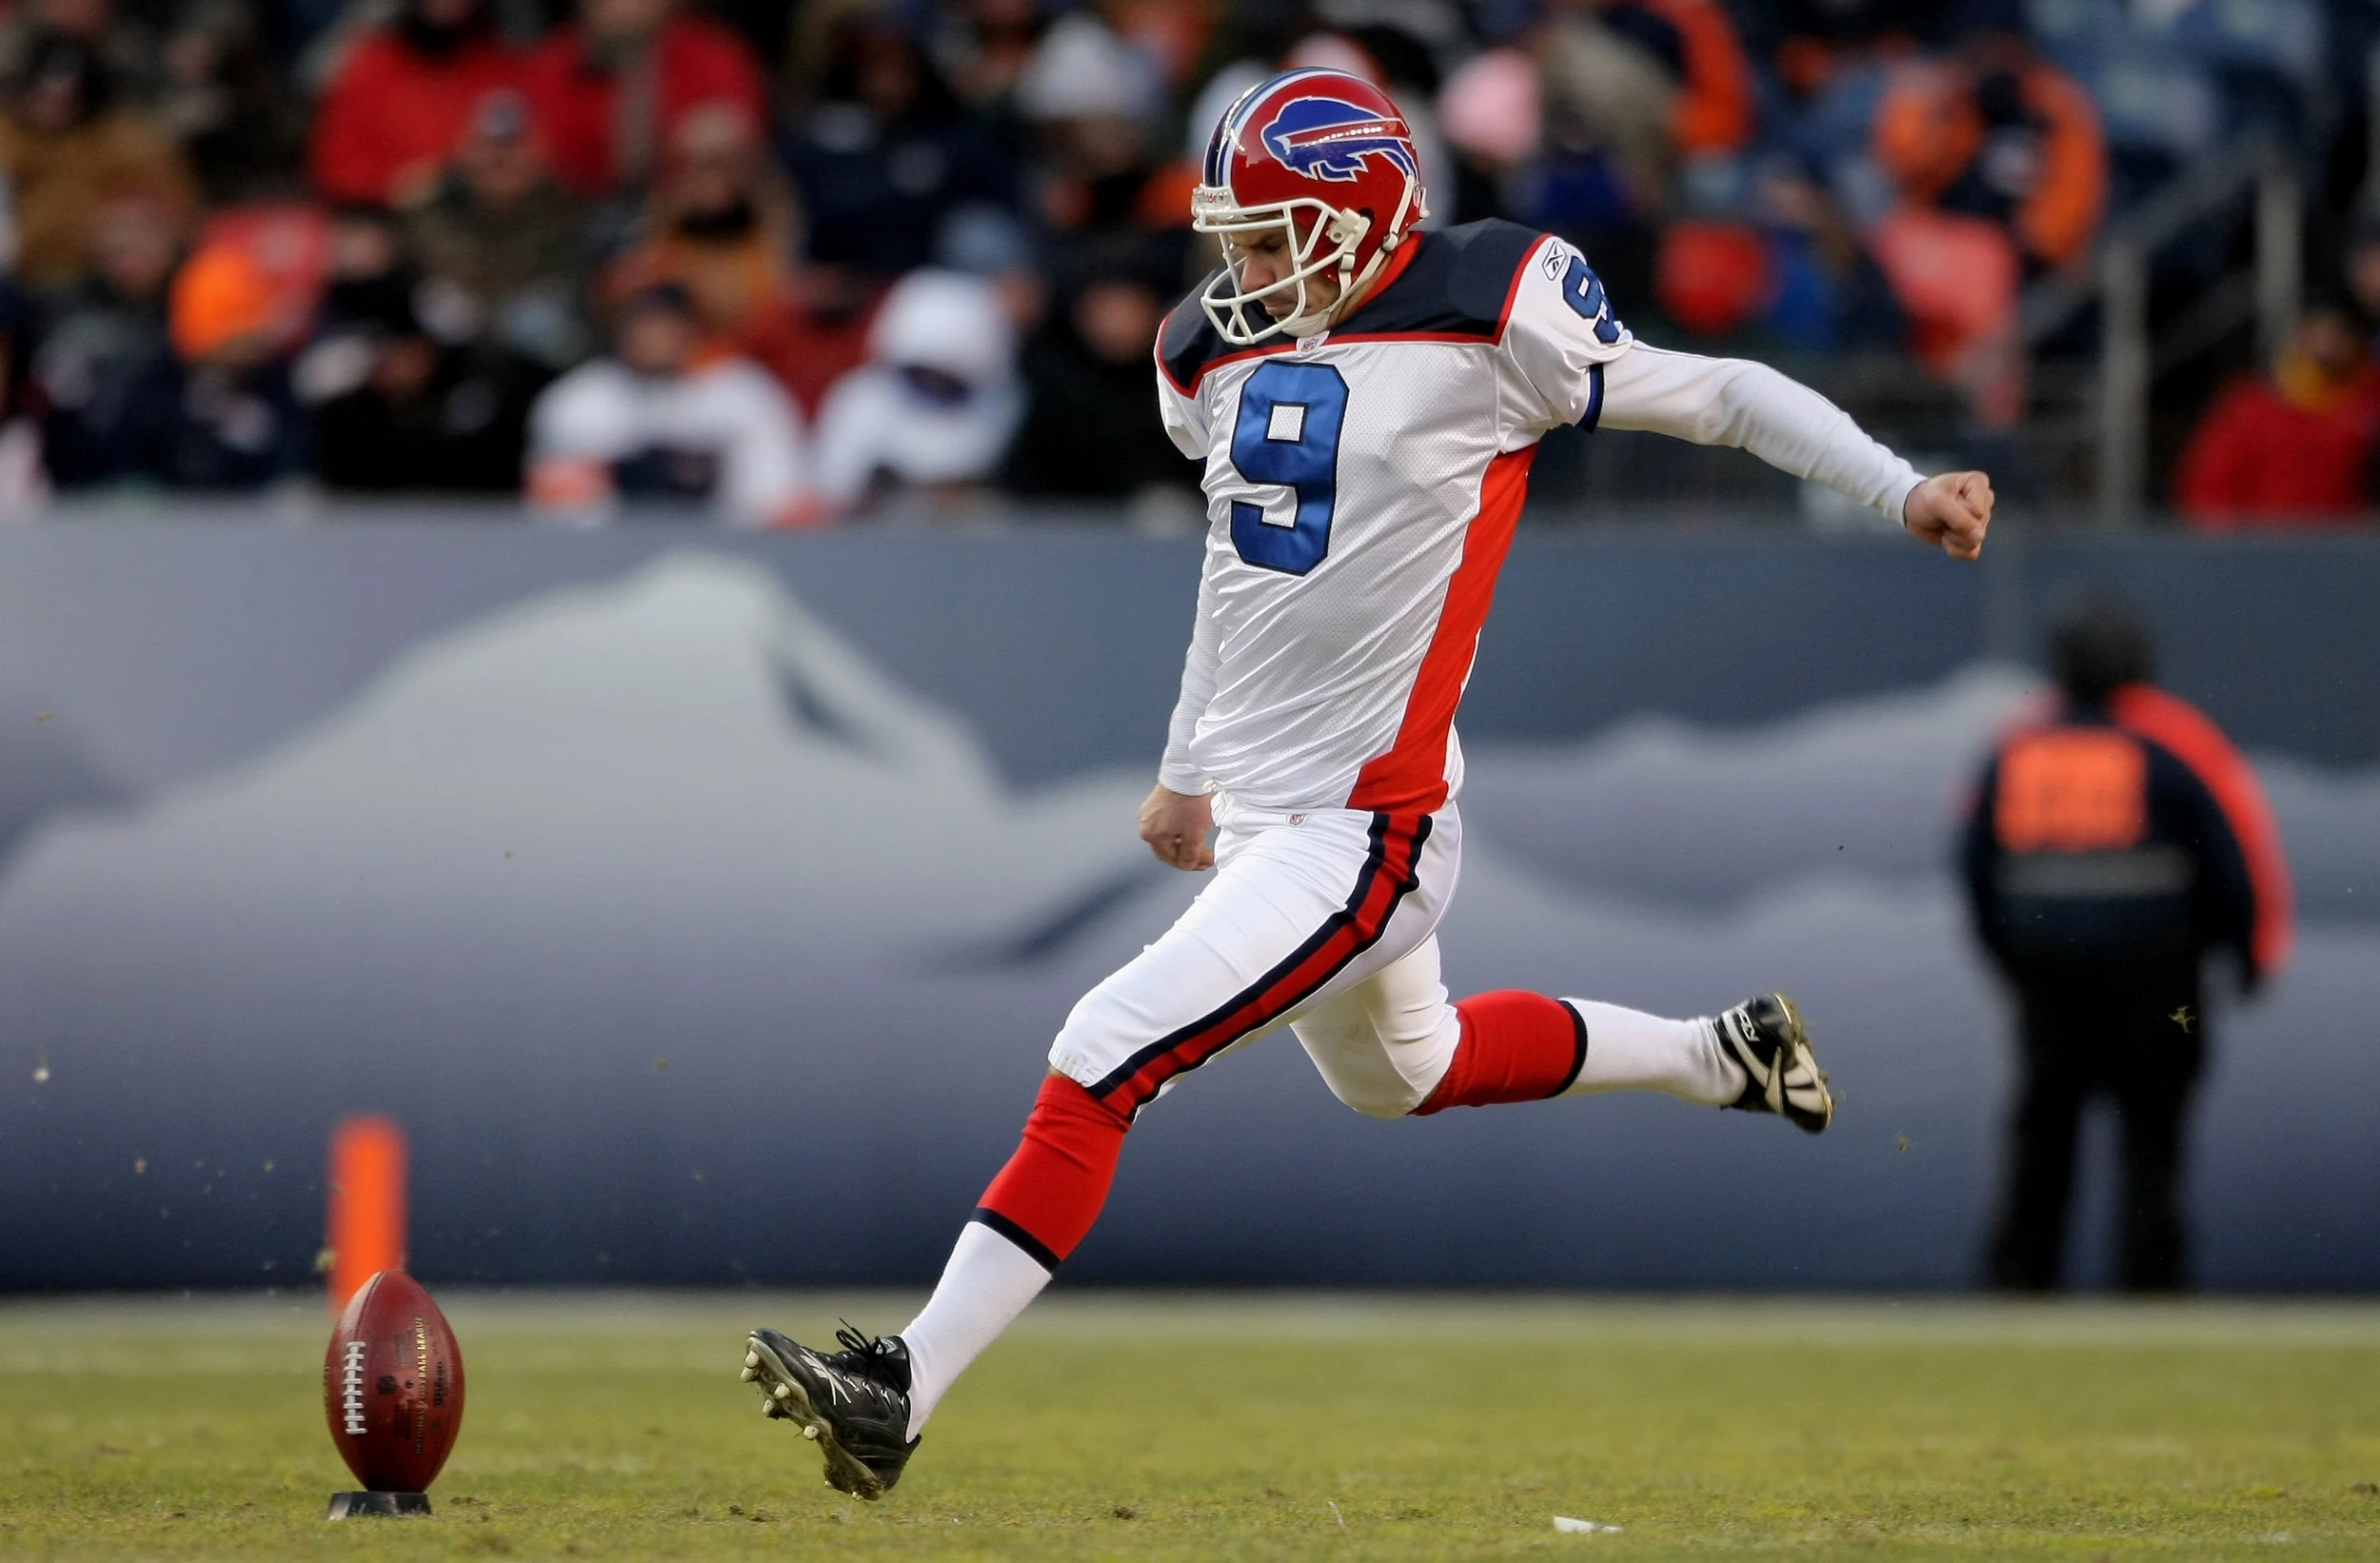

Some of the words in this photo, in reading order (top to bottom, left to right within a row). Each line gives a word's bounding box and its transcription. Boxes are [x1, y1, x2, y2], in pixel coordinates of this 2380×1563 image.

[1562, 255, 1620, 345] 9
[1229, 359, 1350, 577] 9
[414, 1316, 426, 1351] LEAGUE
[417, 1353, 427, 1405] FOOTBALL
